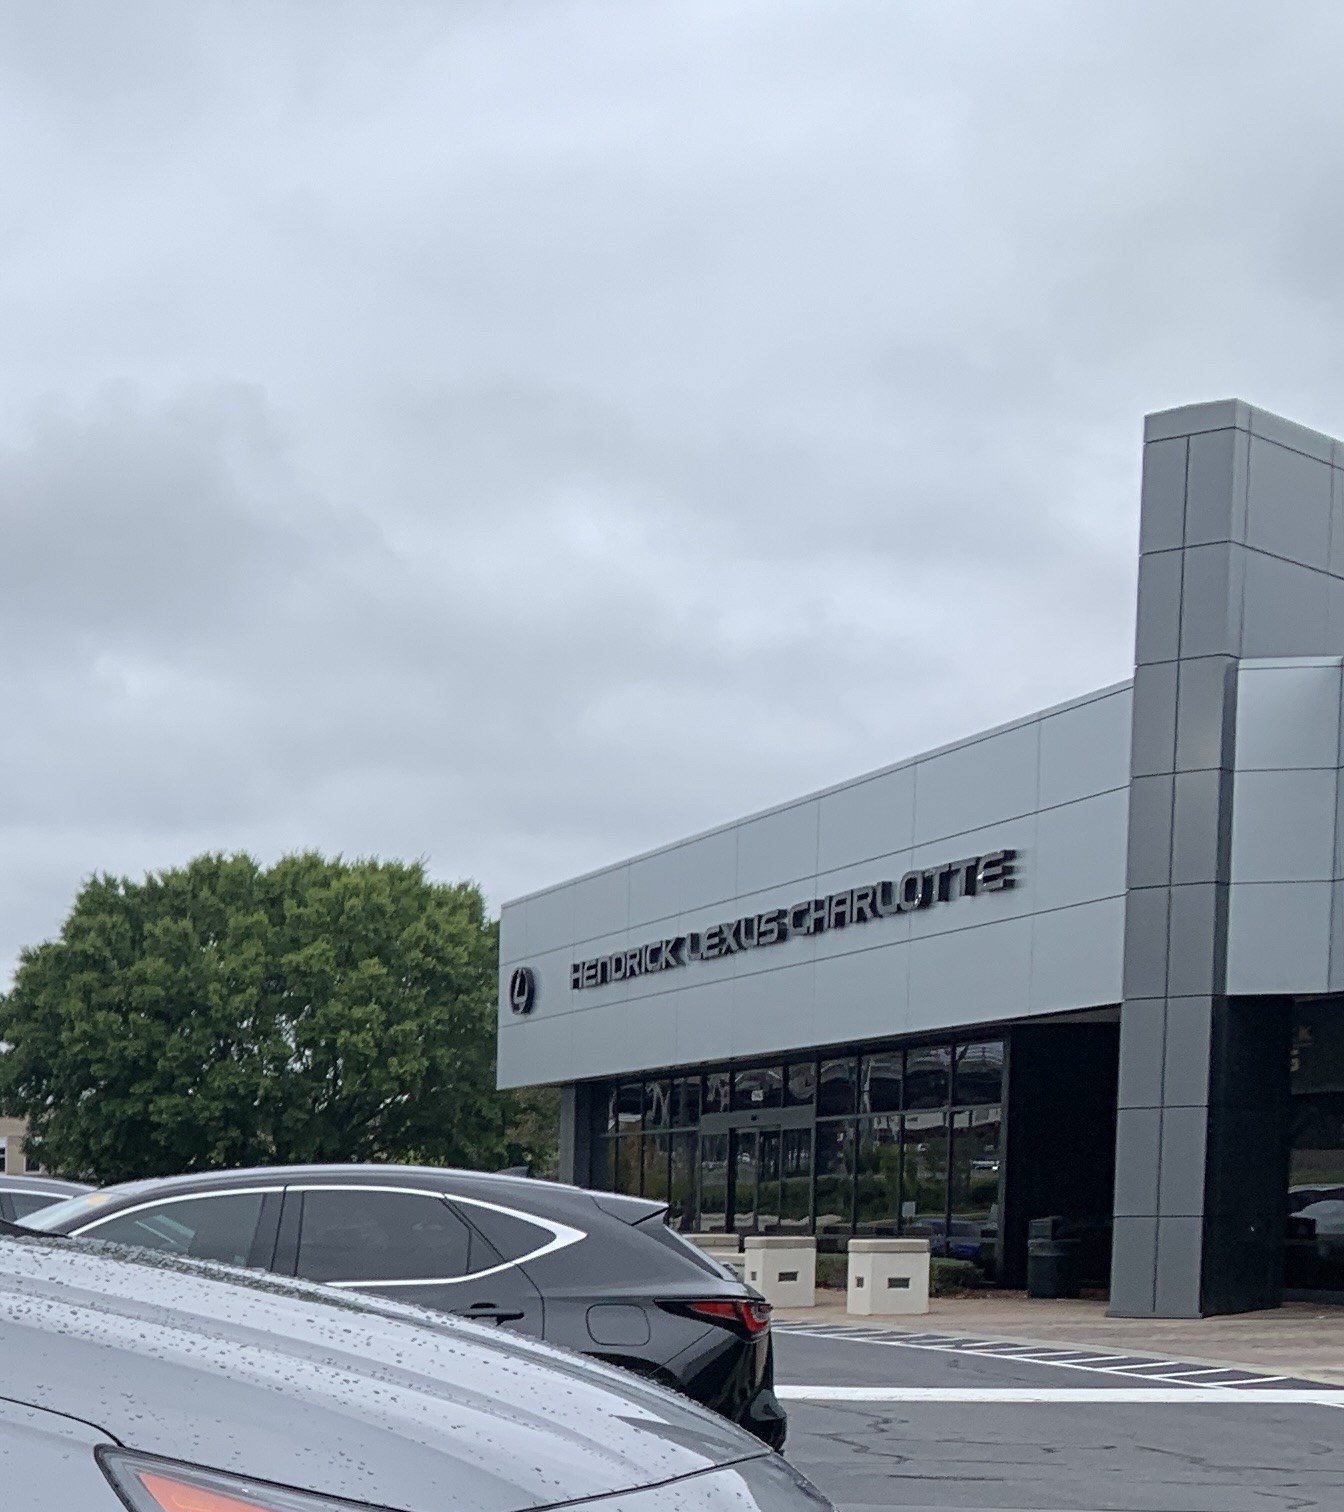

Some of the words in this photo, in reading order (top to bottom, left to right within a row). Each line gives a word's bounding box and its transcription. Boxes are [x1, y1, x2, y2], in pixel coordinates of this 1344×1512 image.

[570, 937, 682, 990] HENDRICK
[685, 909, 787, 961] LEXUS
[789, 849, 1016, 936] CHARLOTTE
